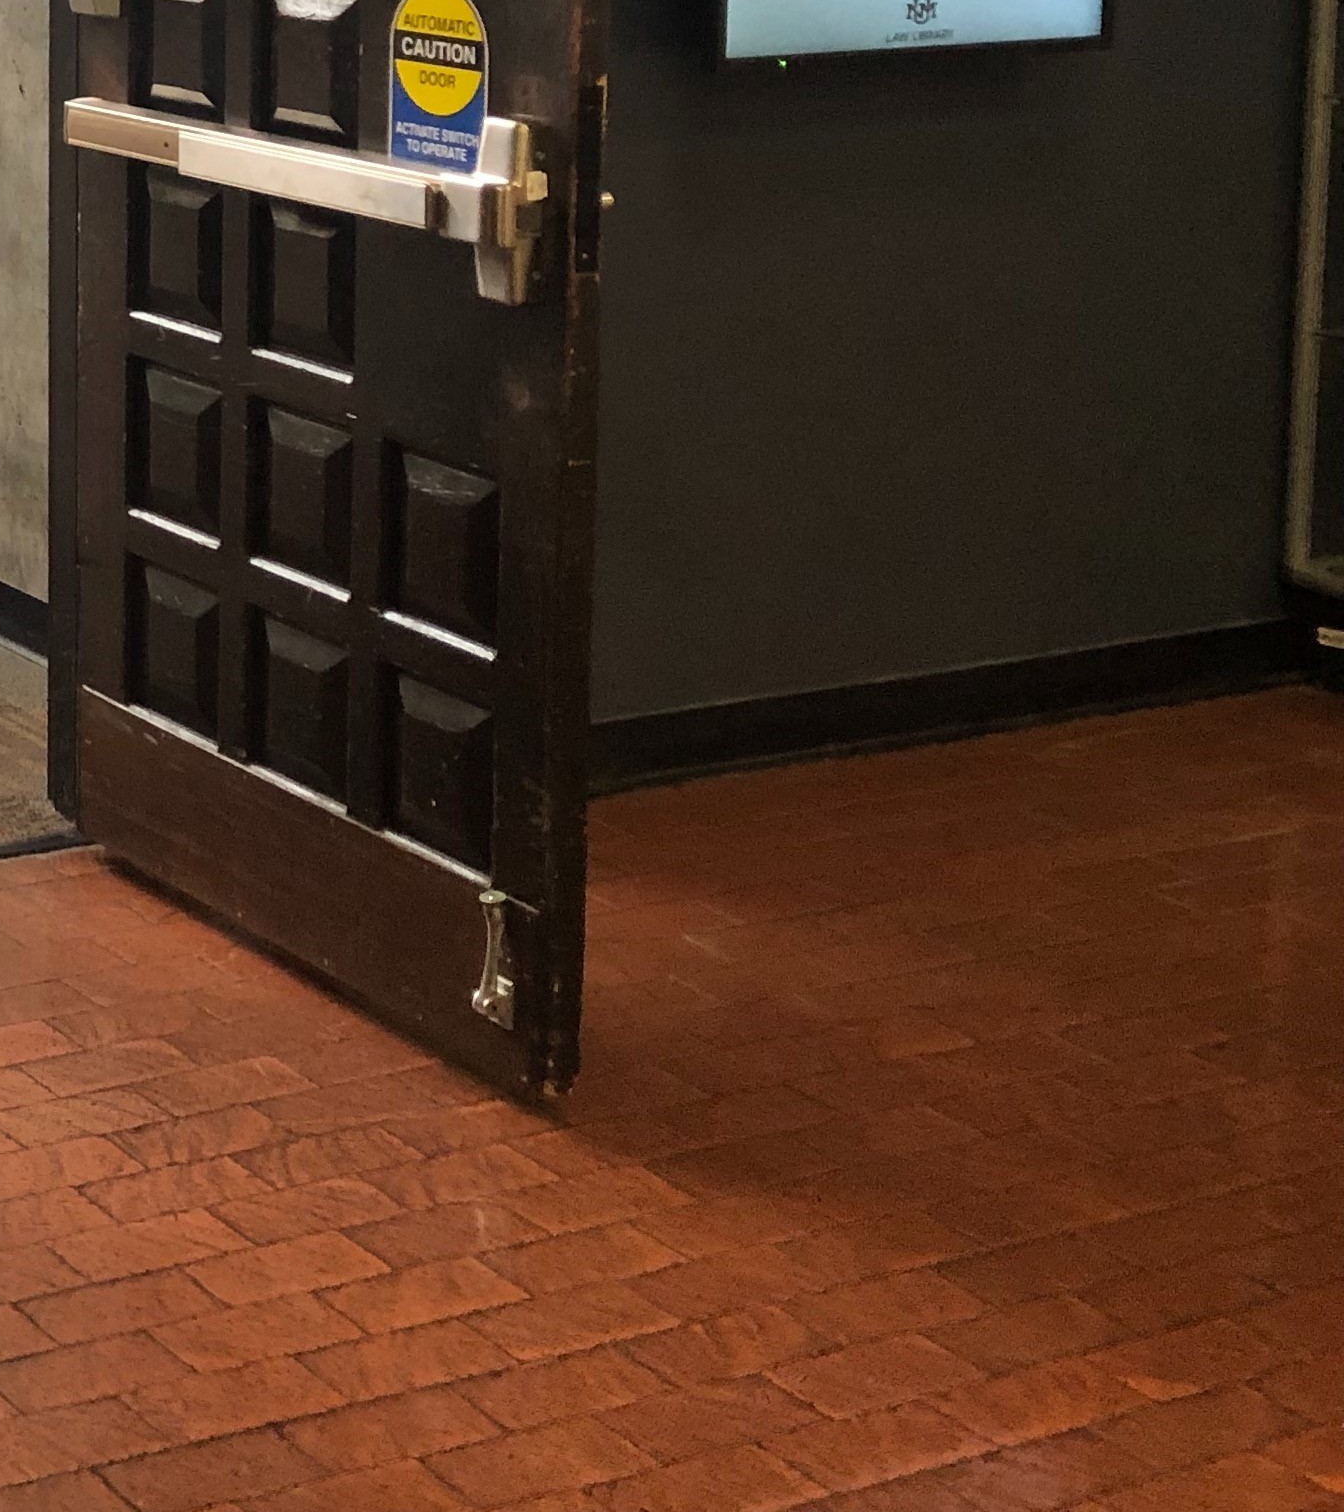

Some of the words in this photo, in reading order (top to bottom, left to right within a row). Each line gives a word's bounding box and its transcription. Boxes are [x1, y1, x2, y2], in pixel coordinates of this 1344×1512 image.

[403, 13, 475, 36] AUTOMATIC
[402, 37, 476, 65] CAUTION
[420, 70, 456, 89] DOOR
[396, 121, 440, 141] ACTIVATE
[442, 129, 479, 148] SWITCH
[406, 139, 421, 151] TO
[423, 142, 467, 162] OPERATE
